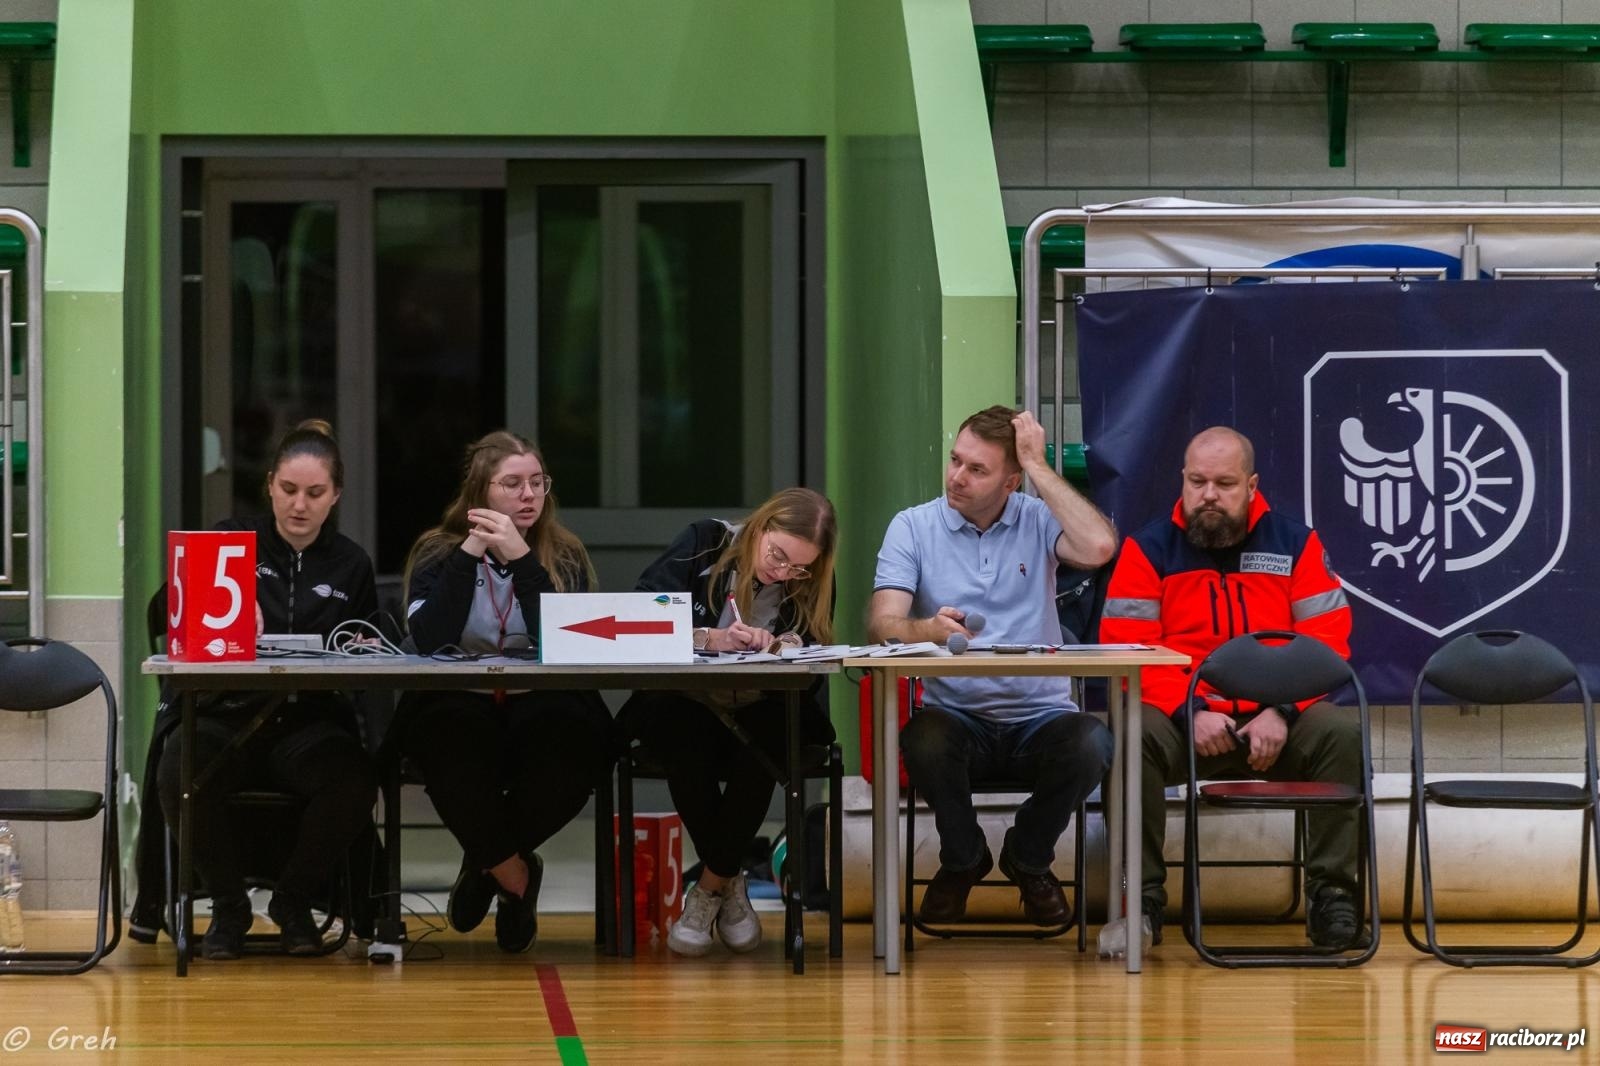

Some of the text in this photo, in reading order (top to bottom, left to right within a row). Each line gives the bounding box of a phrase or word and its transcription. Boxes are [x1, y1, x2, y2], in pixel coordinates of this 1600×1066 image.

[170, 545, 185, 629] 5
[201, 545, 246, 630] 5
[1242, 563, 1290, 573] MEDYCZNY
[1243, 555, 1289, 565] RATOWNIK
[663, 827, 679, 907] 5
